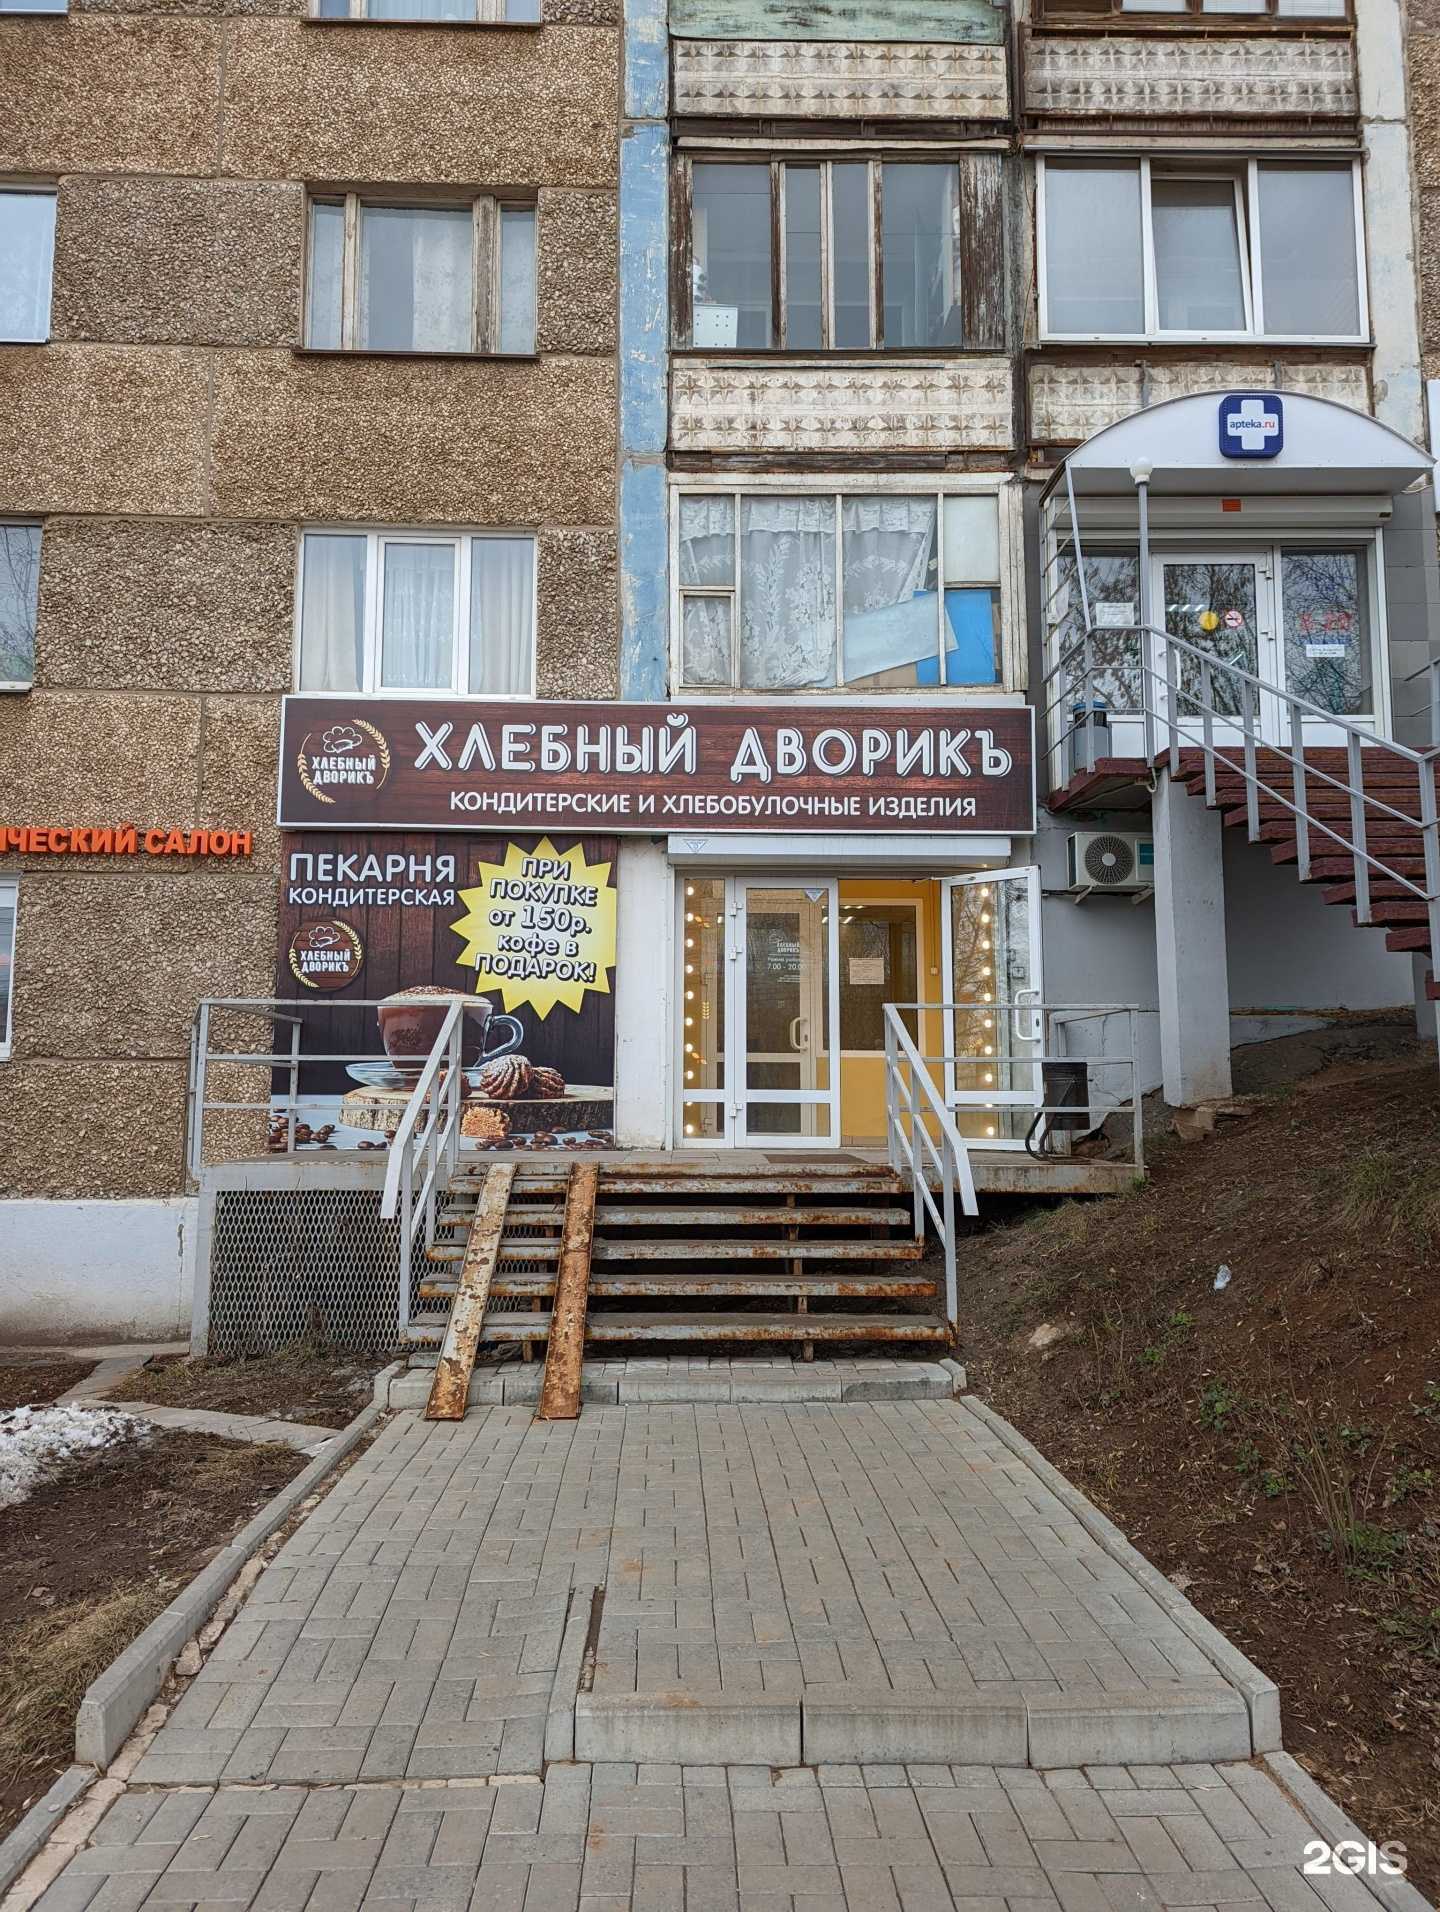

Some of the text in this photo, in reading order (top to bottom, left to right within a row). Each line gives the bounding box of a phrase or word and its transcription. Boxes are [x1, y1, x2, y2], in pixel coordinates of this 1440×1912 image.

[1229, 419, 1276, 431] apteka.ru
[414, 712, 1013, 784] ХЛЕБНЫЙ ДВОРИКЪ
[311, 754, 377, 771] ХЛЕБНЫЙ
[312, 770, 375, 786] ДВОРИКЪ
[449, 791, 977, 819] КОНДИТЕРСКИЕ И ХЛЕБОБУЛОЧНЫЕ ИЗДЕЛИЯ
[143, 829, 253, 856] САЛОН
[289, 853, 456, 884] ПЕКАРНЯ
[521, 857, 571, 881] ПРИ
[288, 887, 456, 908] КОНДИТЕРСКАЯ
[489, 878, 598, 906] ПОКУПКЕ
[489, 905, 592, 938] от 150р.
[300, 948, 351, 962] ХЛЕБНЫЙ
[497, 931, 579, 958] кофе в
[301, 961, 350, 974] ДВОРИКЪ
[474, 952, 597, 983] ПОДАРОК!
